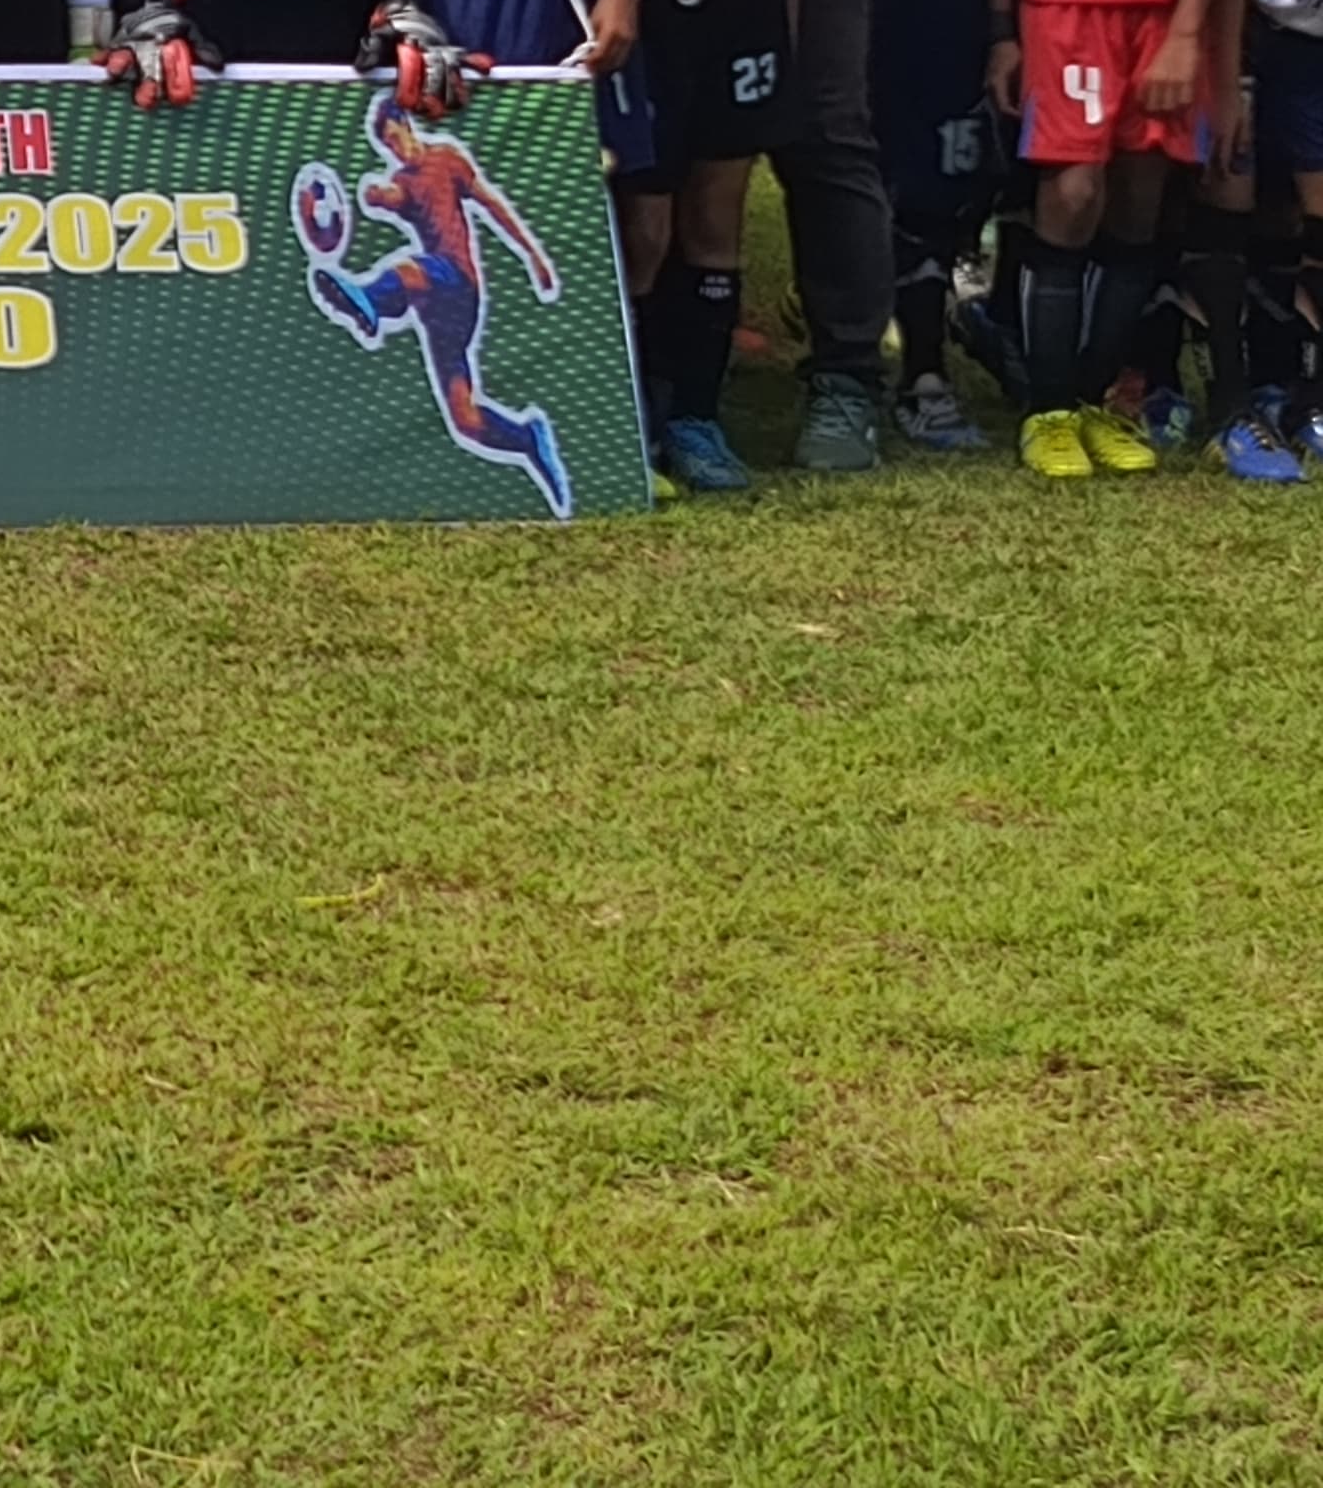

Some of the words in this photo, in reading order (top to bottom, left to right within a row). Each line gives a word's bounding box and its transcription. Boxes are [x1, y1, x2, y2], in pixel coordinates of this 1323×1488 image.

[731, 52, 776, 104] 23
[1062, 64, 1104, 126] 4
[936, 118, 981, 175] 15
